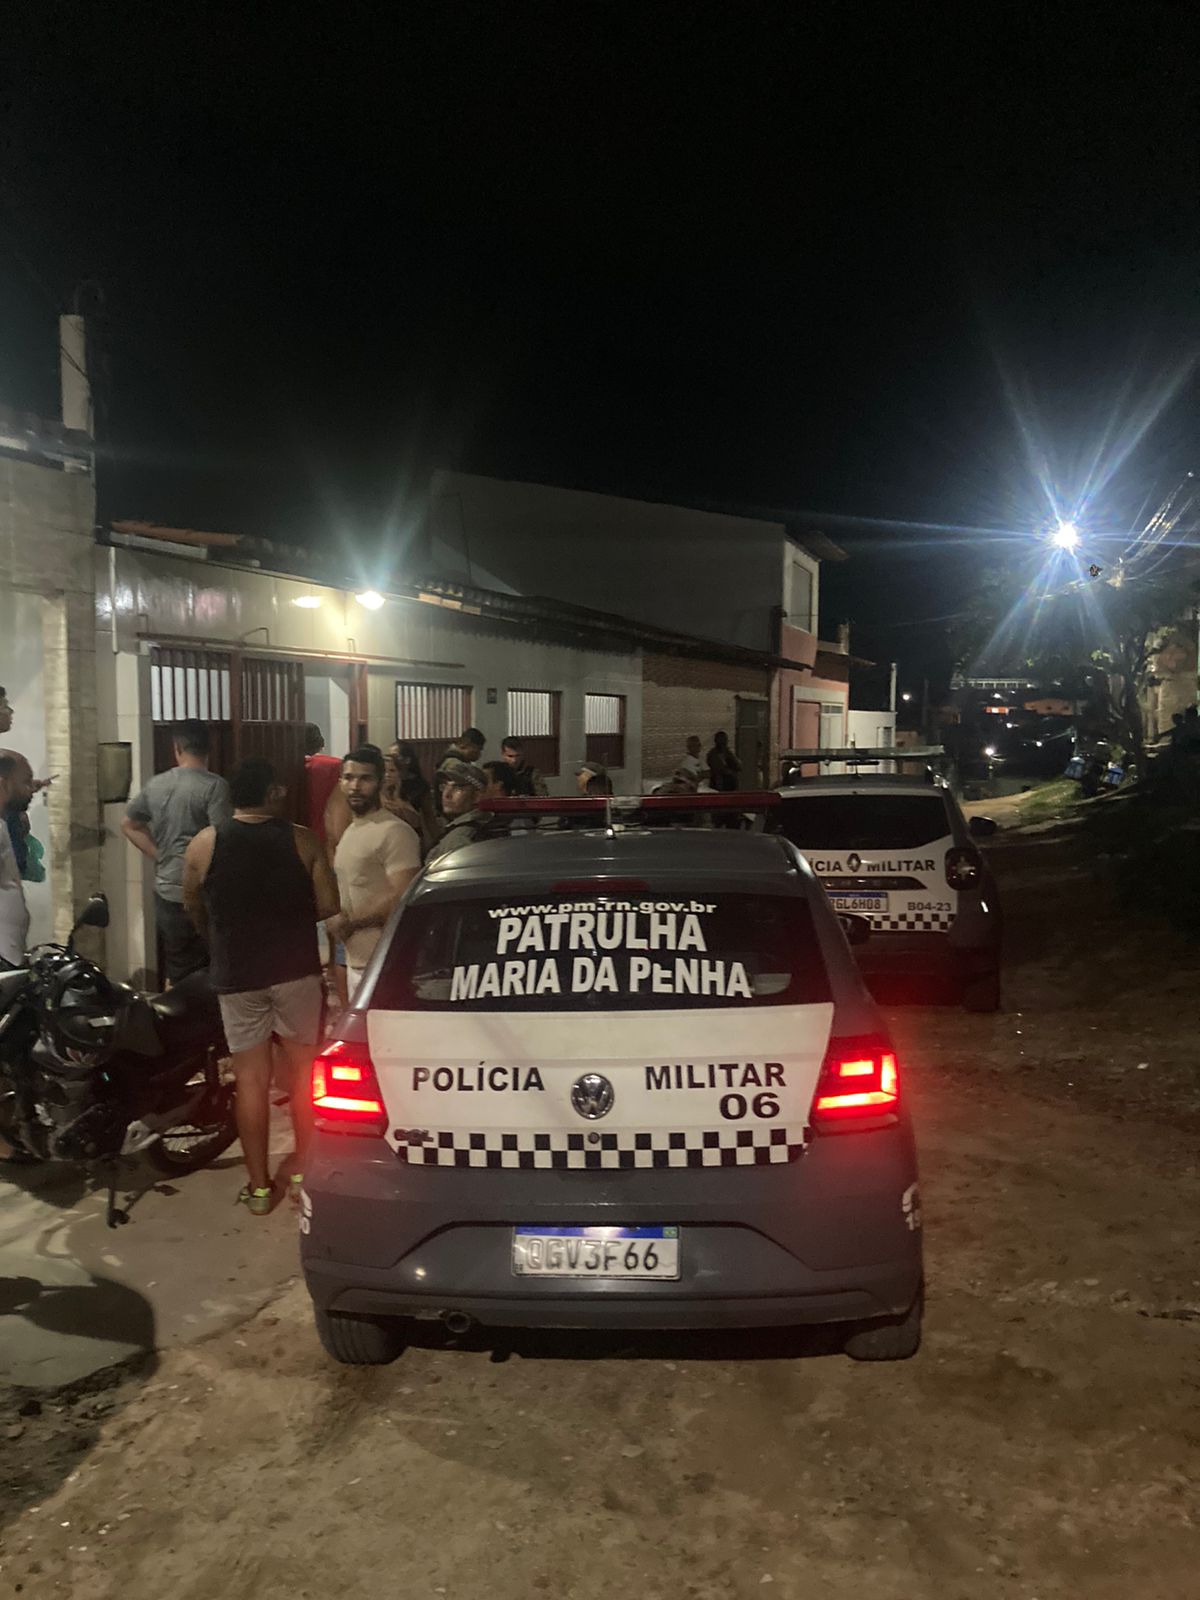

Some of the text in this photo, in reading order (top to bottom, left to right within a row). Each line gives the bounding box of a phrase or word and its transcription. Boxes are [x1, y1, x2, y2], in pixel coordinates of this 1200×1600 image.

[867, 859, 936, 872] MILITAR
[488, 900, 717, 919] www.pm.rn.gov.br
[907, 902, 952, 912] B04-23
[496, 912, 708, 955] PATRULHA
[450, 956, 752, 1002] MARIA DA PENHA
[412, 1061, 787, 1092] POLÍCIA MILITAR
[719, 1092, 781, 1120] 06
